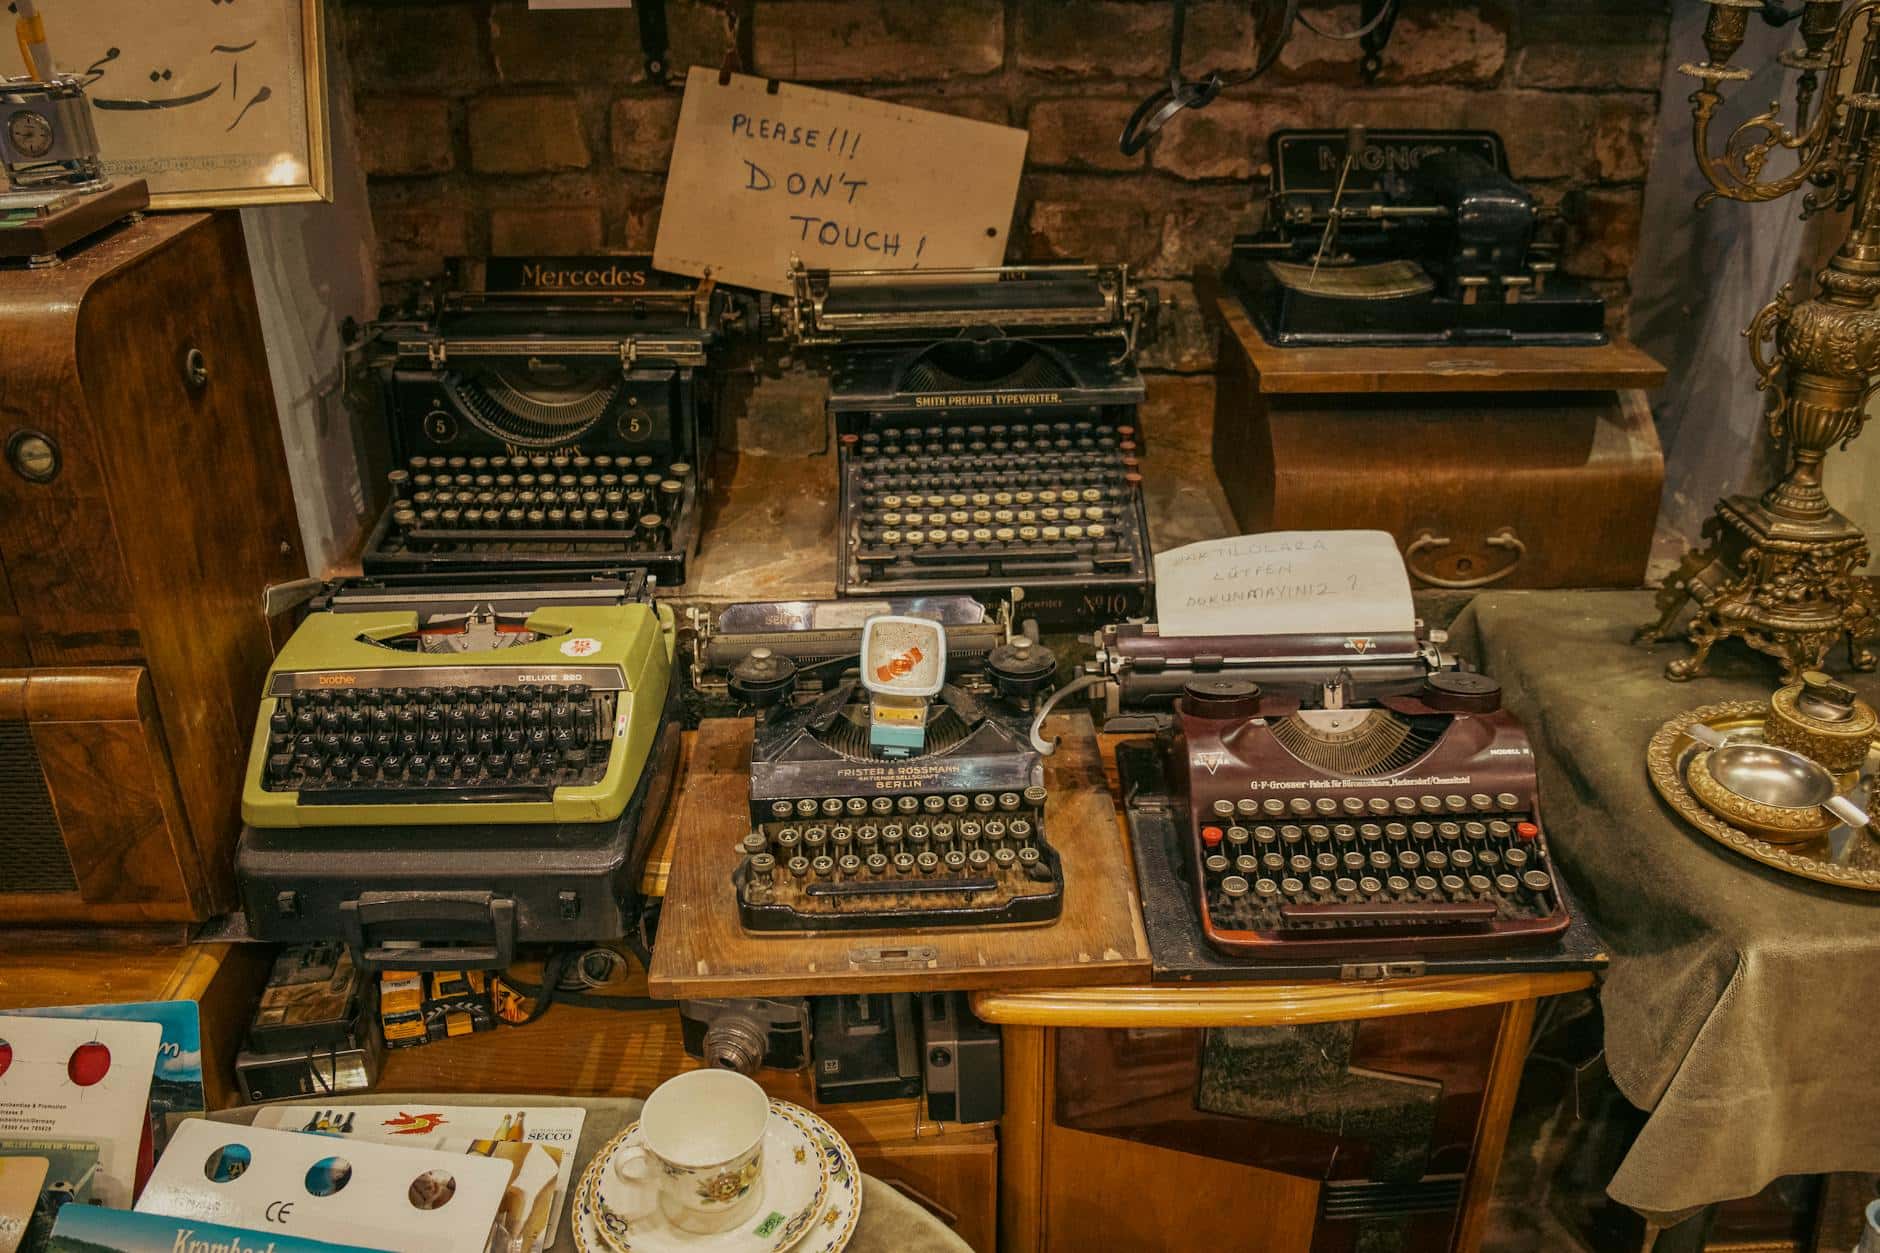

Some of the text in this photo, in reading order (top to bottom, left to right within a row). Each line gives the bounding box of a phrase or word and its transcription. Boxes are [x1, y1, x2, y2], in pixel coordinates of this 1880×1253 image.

[731, 113, 861, 160] PLEASE!!!
[743, 159, 868, 204] DON'T
[790, 215, 900, 256] TOUCH
[521, 264, 647, 287] Mercedes
[915, 396, 946, 408] SMITH
[949, 395, 993, 406] PREMIER
[436, 420, 446, 433] 5
[630, 418, 640, 432] 5
[319, 675, 356, 686] brother
[518, 674, 557, 682] DELUXE
[837, 768, 884, 777] FRISTER
[875, 781, 922, 789] BERLIN
[528, 1132, 572, 1141] SECCO
